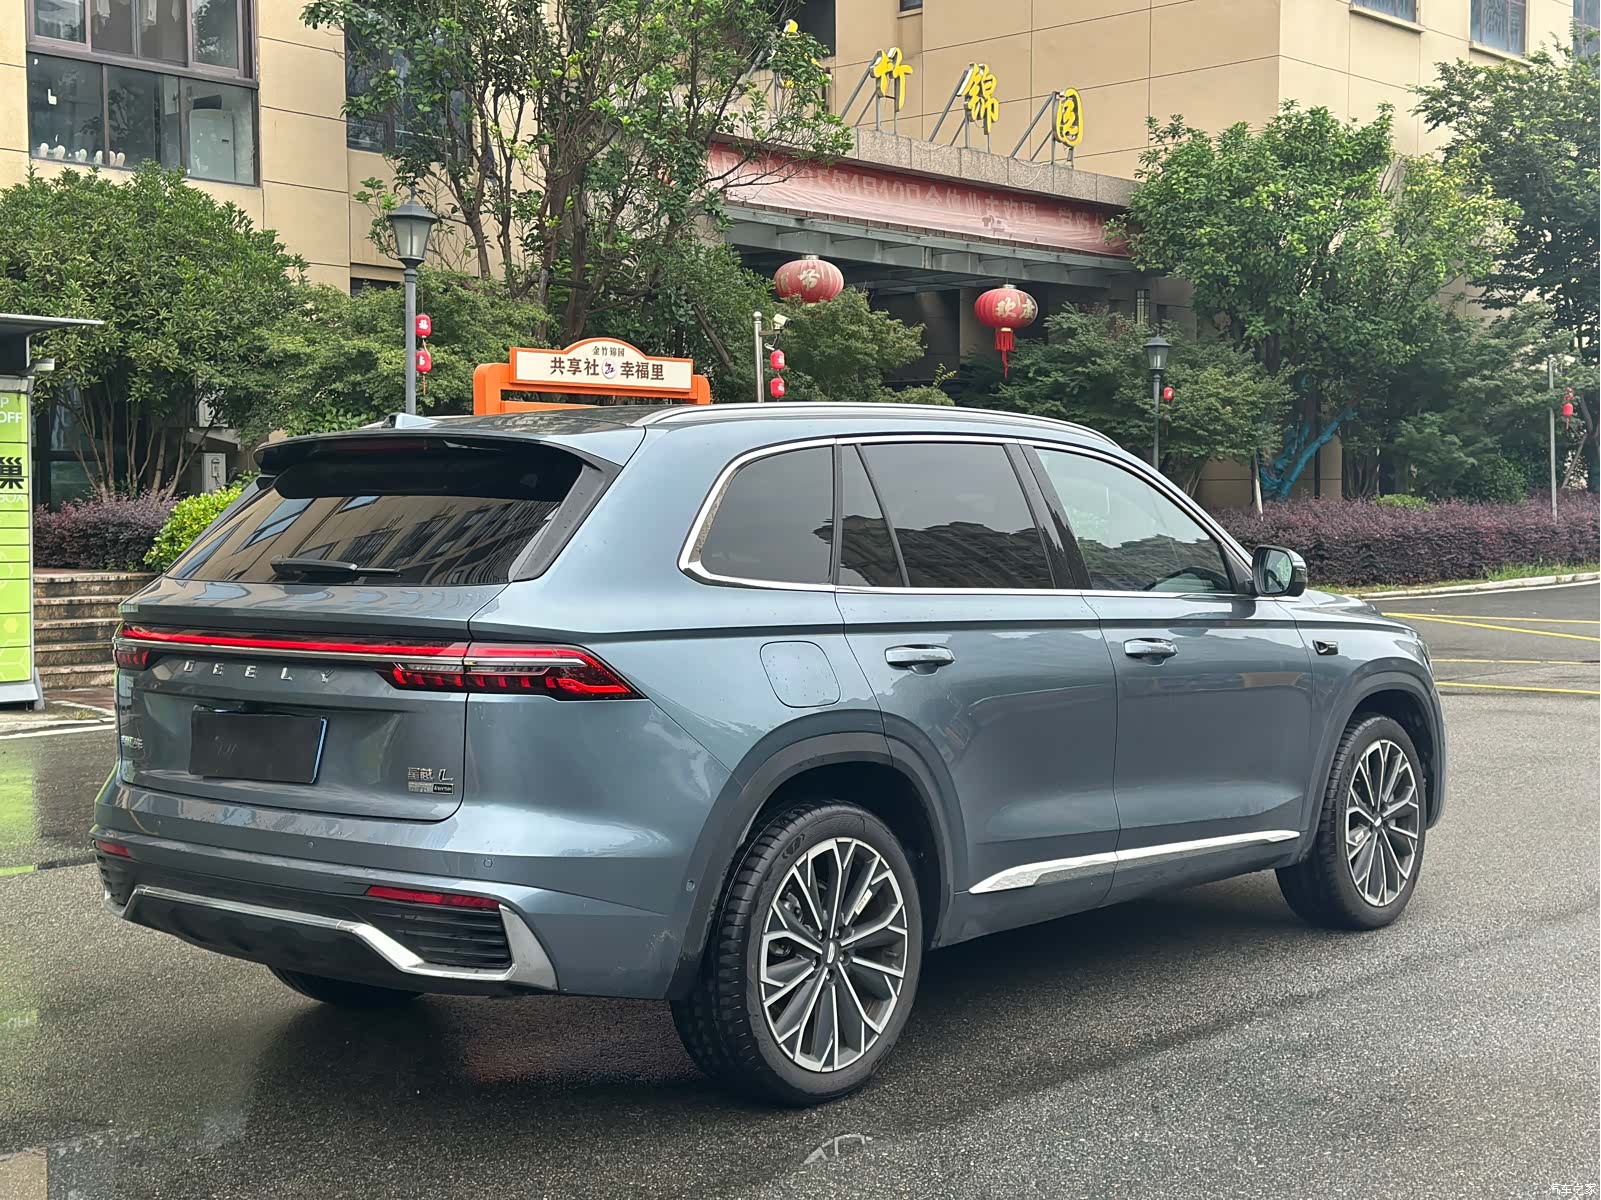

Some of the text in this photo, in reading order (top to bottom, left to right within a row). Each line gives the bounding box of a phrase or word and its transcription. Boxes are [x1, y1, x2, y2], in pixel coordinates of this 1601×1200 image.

[550, 357, 600, 376] 共享社
[620, 361, 664, 380] 幸福里
[184, 659, 336, 683] GEELY
